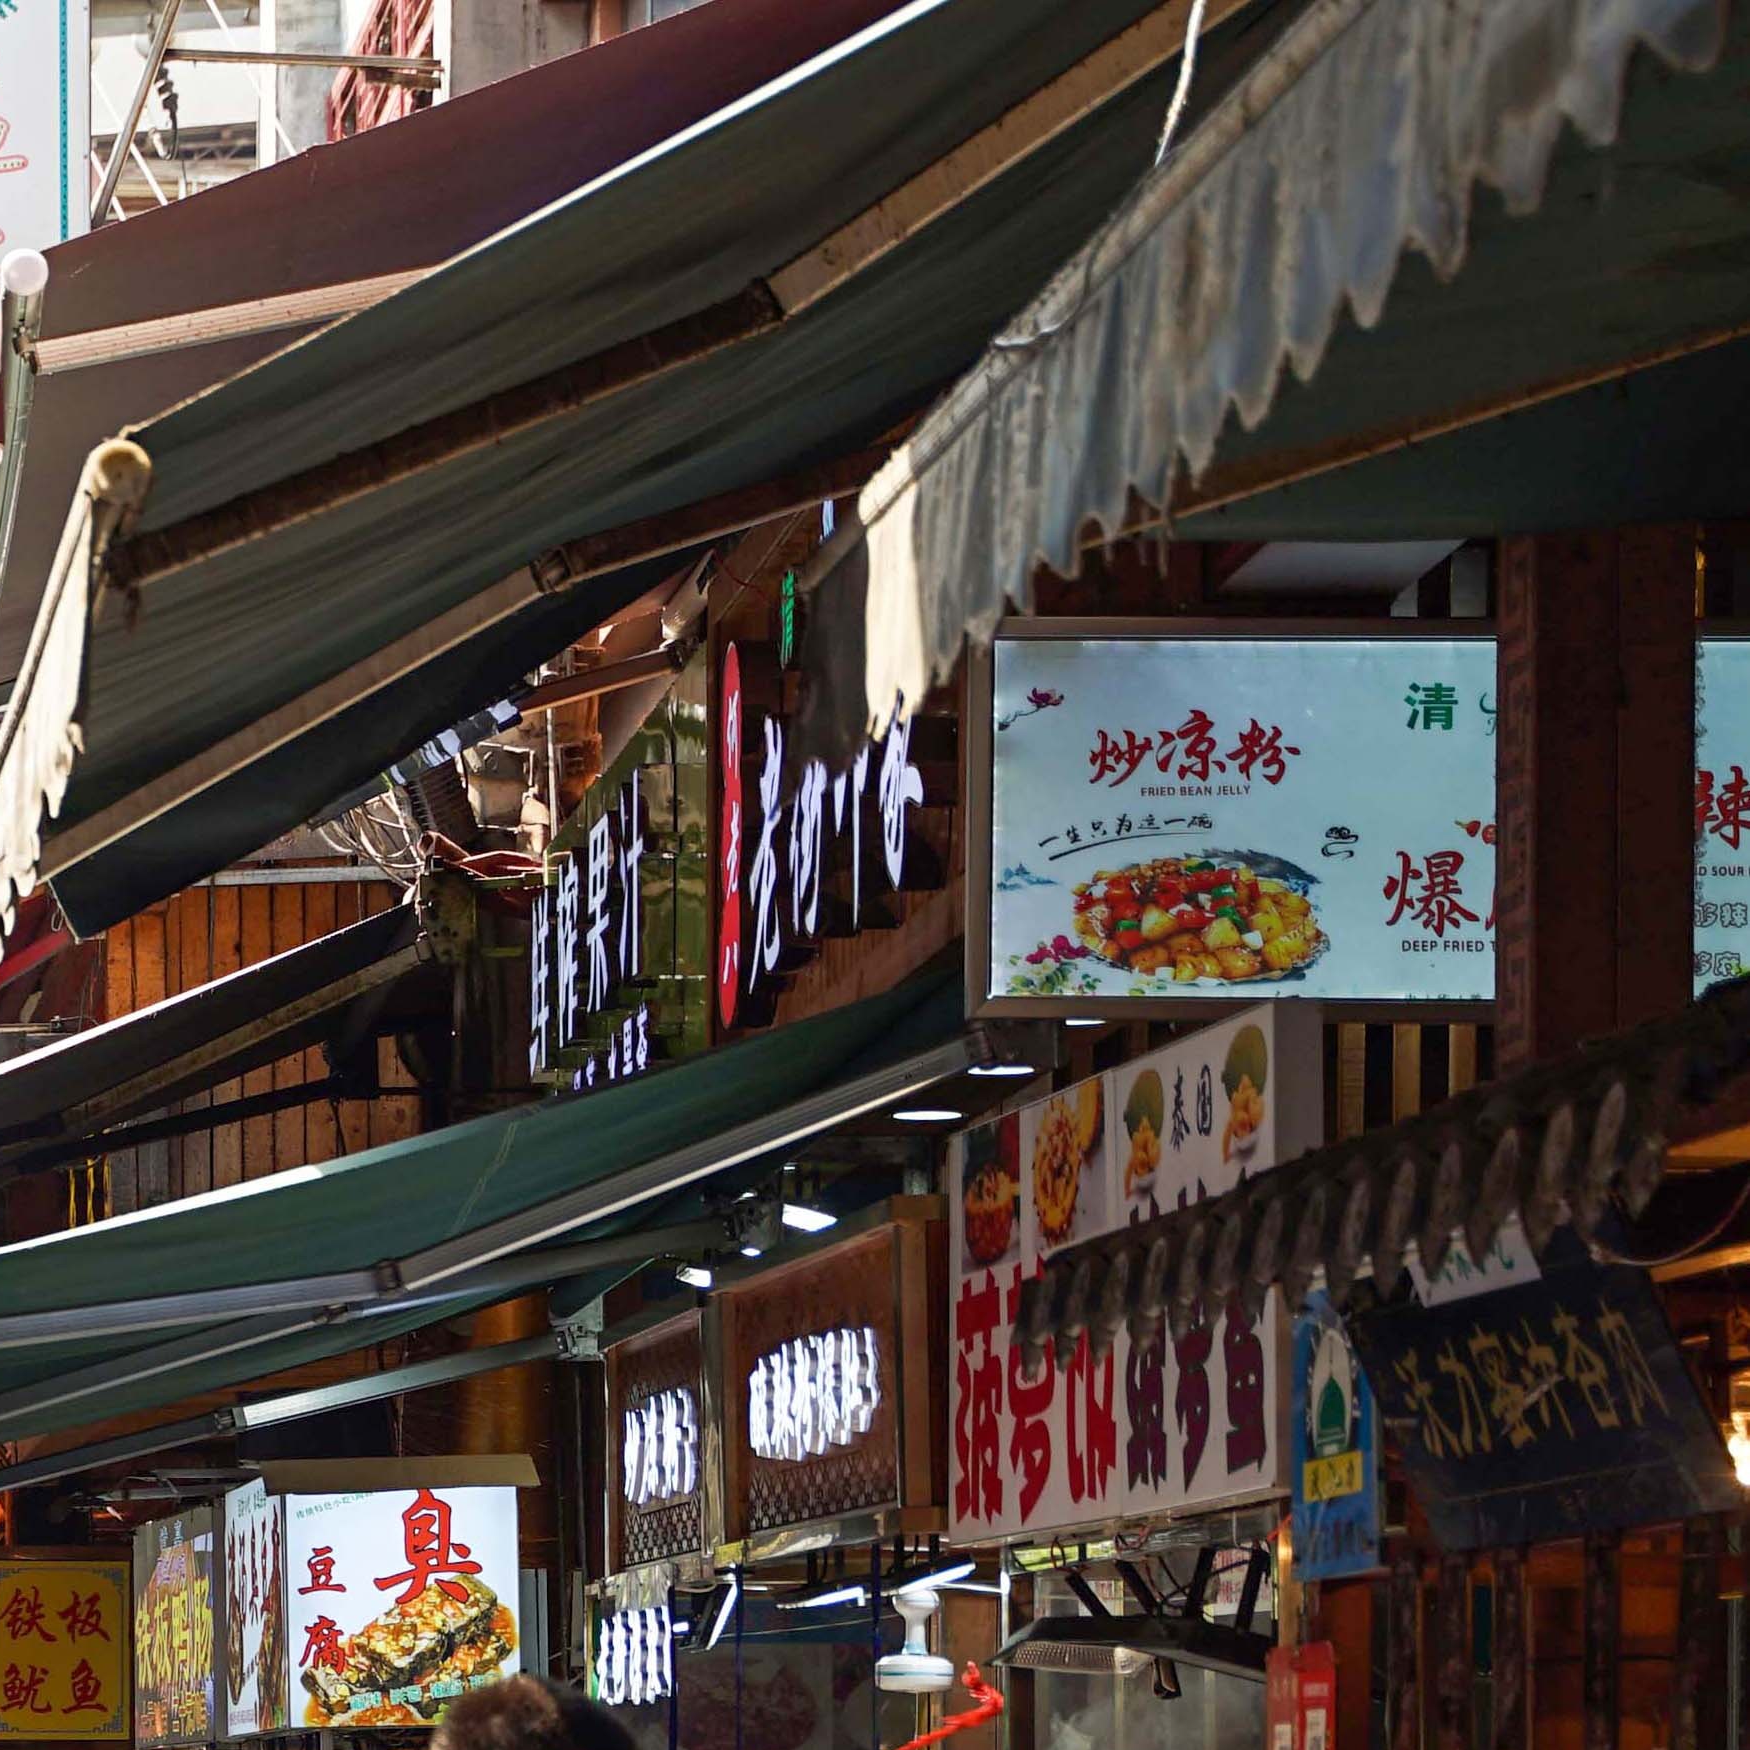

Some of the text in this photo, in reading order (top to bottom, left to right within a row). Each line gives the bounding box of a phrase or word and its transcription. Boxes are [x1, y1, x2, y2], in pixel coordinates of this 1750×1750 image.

[1088, 709, 1302, 789] 炒凉粉
[1140, 783, 1251, 797] FRIED BEAN JELLY
[1711, 865, 1745, 877] SOUR
[1401, 940, 1439, 953] DEEP
[1443, 940, 1485, 953] FRIED
[1172, 1064, 1213, 1150] 泰国
[373, 1487, 484, 1605] 臭
[297, 1545, 348, 1676] 豆腐
